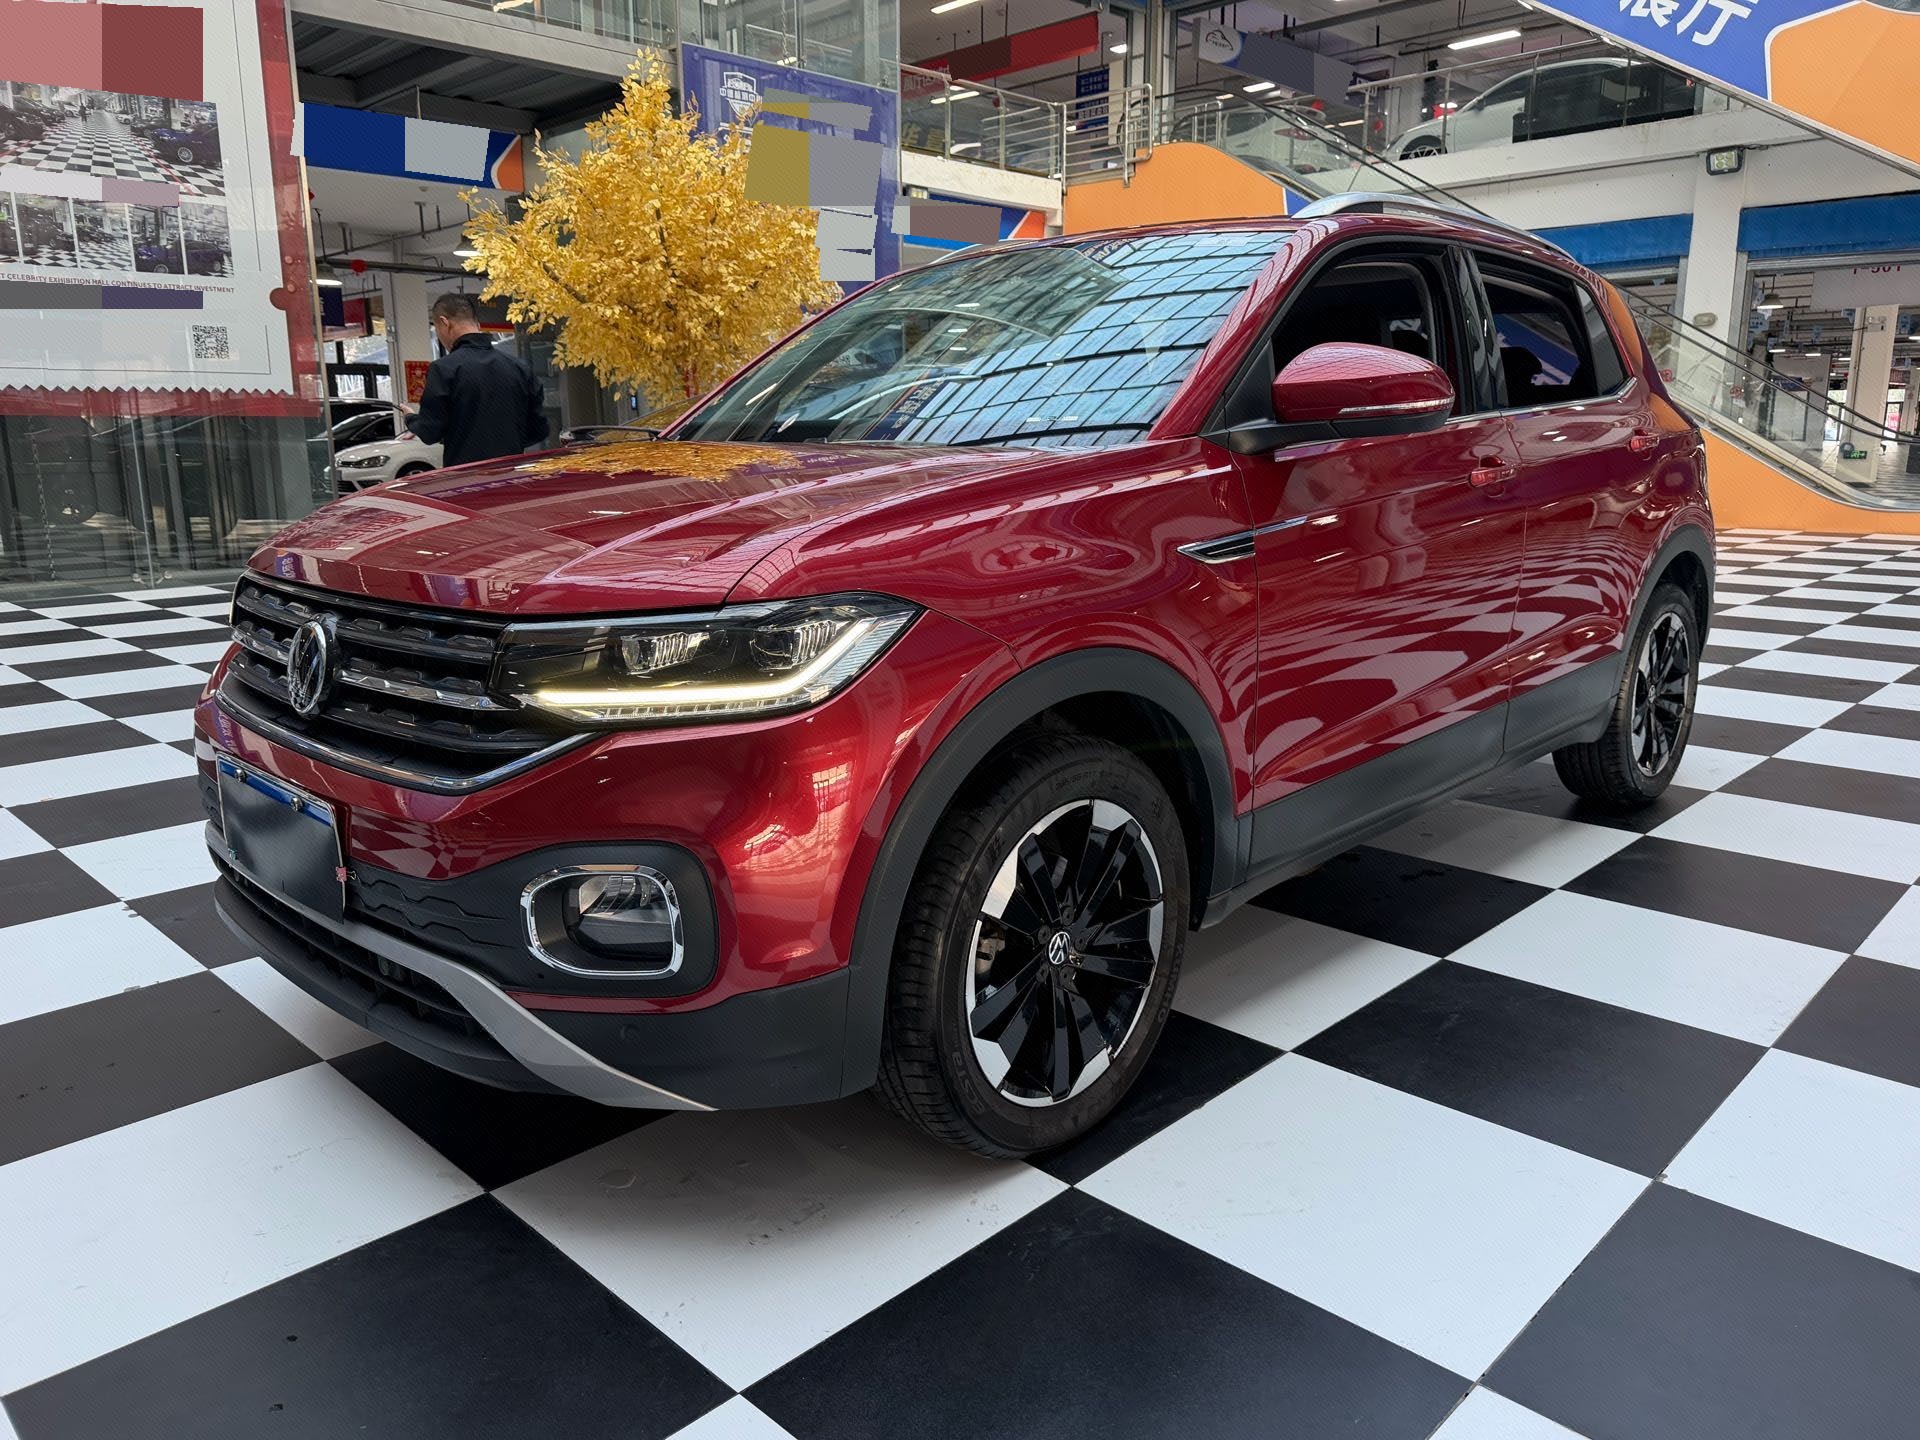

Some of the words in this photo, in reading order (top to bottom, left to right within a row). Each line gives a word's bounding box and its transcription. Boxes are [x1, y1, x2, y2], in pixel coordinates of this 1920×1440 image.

[7, 273, 47, 282] CELEBRITY
[49, 276, 91, 285] EXHIBITION
[111, 280, 152, 289] CONTINUES
[194, 285, 235, 293] INVESTMENT
